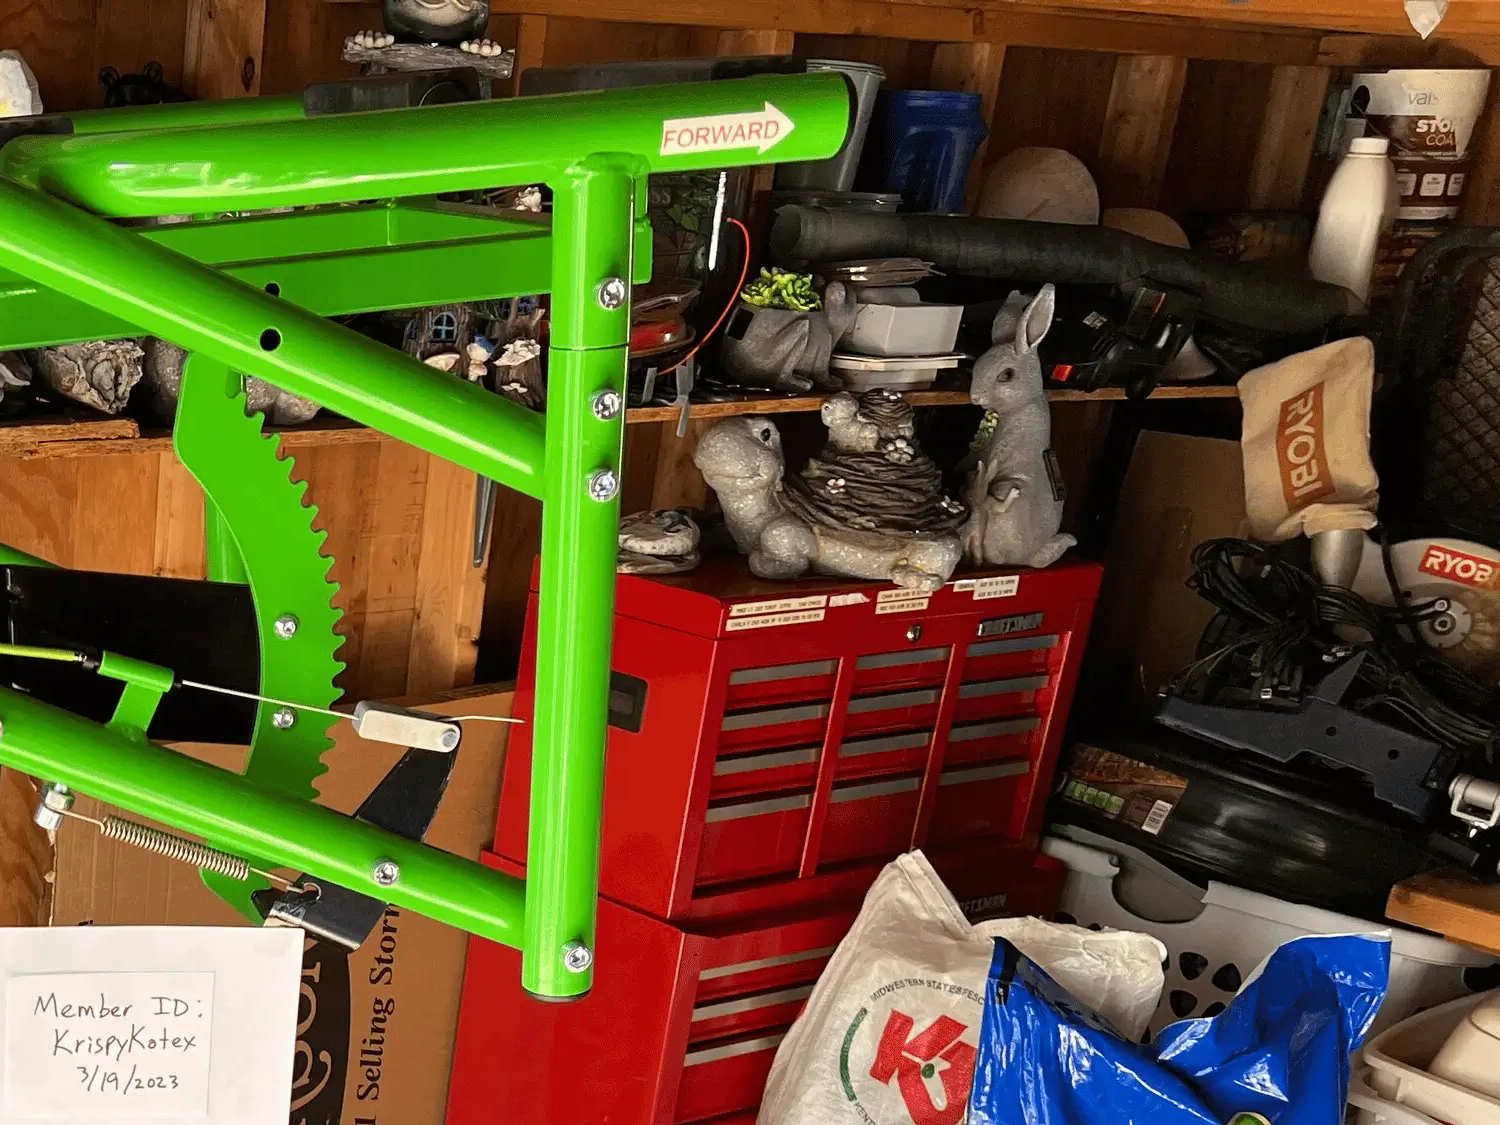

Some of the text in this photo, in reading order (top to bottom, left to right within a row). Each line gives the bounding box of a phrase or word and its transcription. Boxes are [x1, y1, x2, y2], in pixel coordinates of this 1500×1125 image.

[663, 120, 780, 149] FORWARD
[1285, 391, 1323, 498] RYOBI
[1425, 550, 1494, 583] RYOB
[34, 992, 203, 1018] Member ID:
[870, 978, 925, 1003] MIDWESTERN
[961, 986, 985, 1006] FESC
[53, 1023, 196, 1062] KrispyKotex
[357, 997, 395, 1100] Selling
[76, 1063, 179, 1095] 3/19/2023
